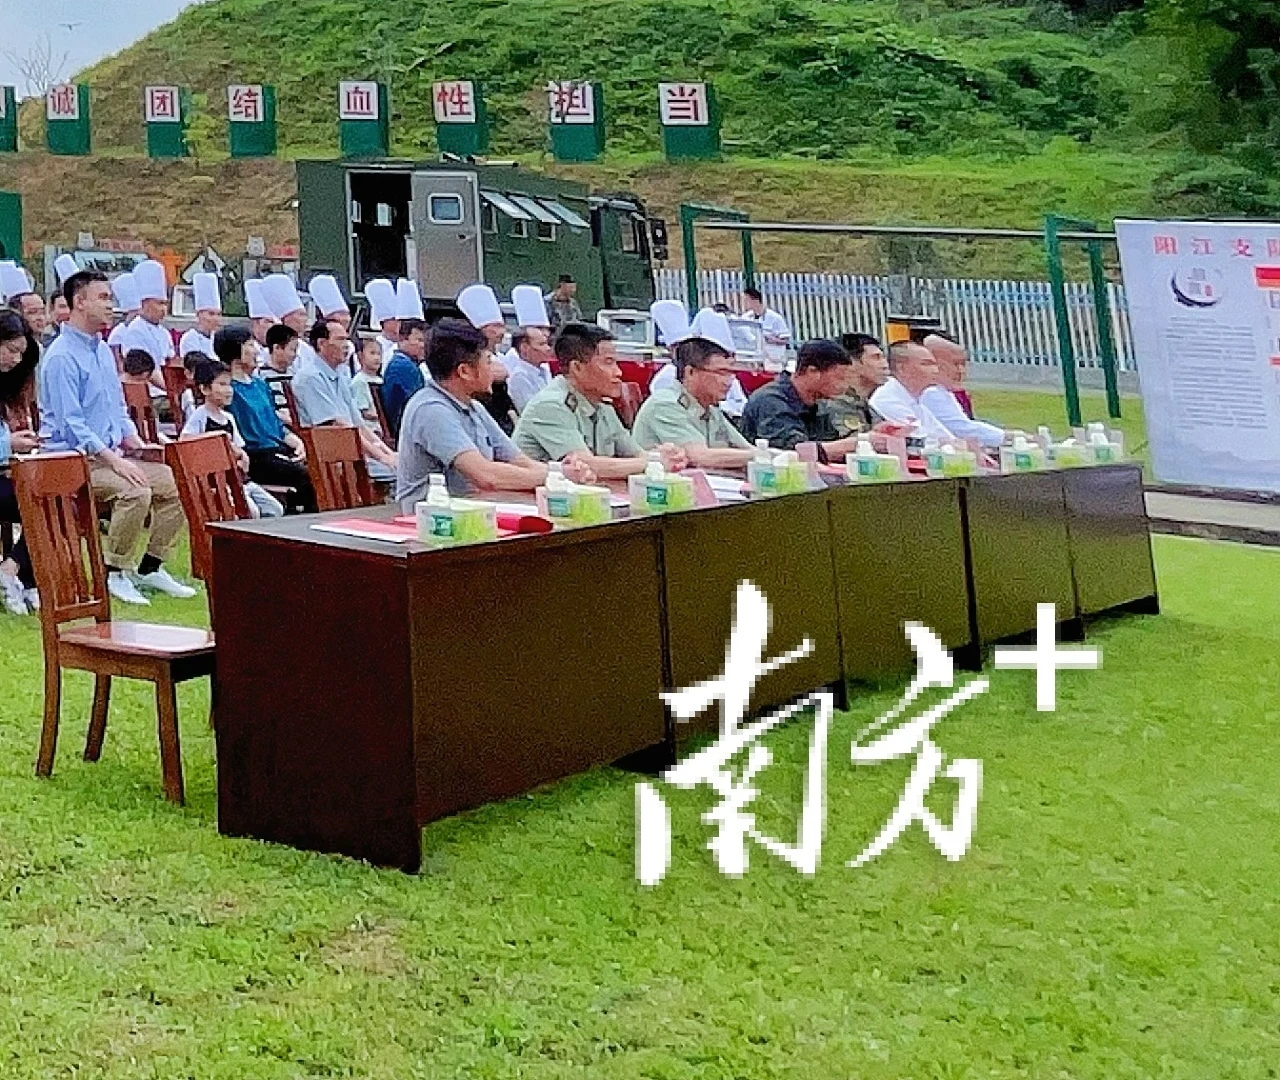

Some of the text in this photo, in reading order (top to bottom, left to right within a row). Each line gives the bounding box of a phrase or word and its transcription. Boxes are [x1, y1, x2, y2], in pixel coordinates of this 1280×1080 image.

[50, 86, 76, 116] 诚
[151, 88, 175, 118] 团
[232, 87, 259, 120] 结
[343, 85, 374, 116] 血
[437, 83, 473, 118] 性
[553, 82, 591, 118] 担
[667, 85, 700, 122] 当
